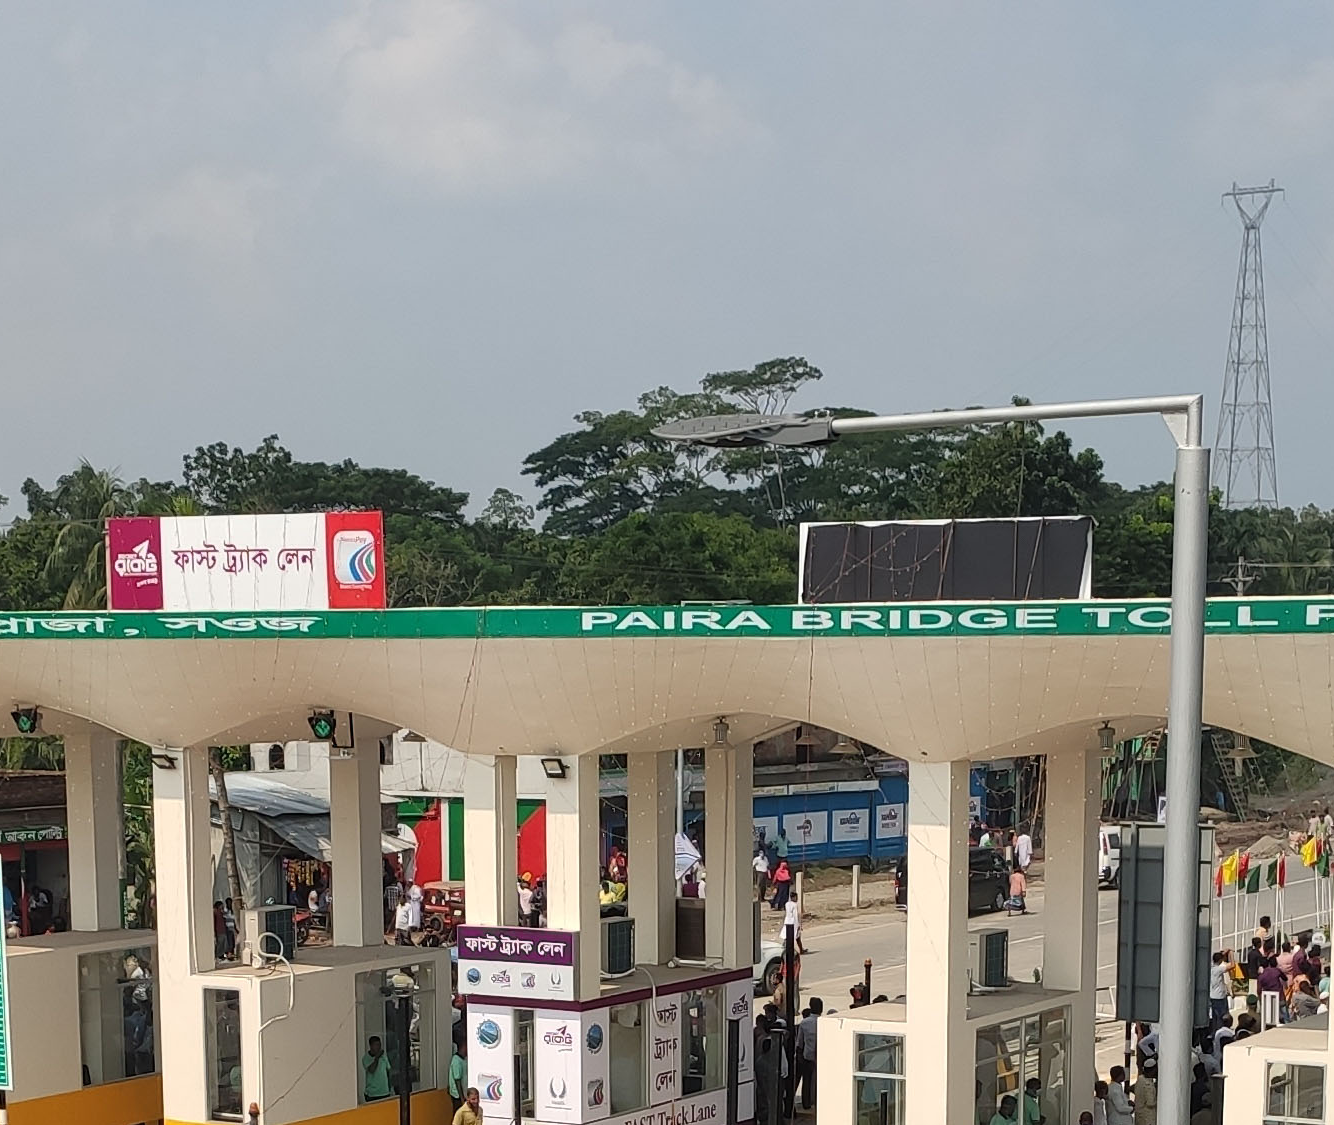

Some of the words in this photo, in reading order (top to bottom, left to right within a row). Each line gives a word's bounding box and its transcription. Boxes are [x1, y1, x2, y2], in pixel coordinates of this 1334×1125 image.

[171, 541, 219, 573] ফাস্ট
[223, 540, 269, 575] ট্র্যাক
[277, 548, 316, 572] লেন
[157, 615, 324, 634] সওজ
[581, 610, 772, 631] PAIRA
[791, 607, 1058, 631] BRIDGE
[1082, 606, 1278, 629] TOL
[464, 934, 499, 952] ফাস্ট
[499, 935, 534, 955] ট্র্যাক
[537, 941, 566, 957] লেন
[688, 1103, 717, 1123] Lane
